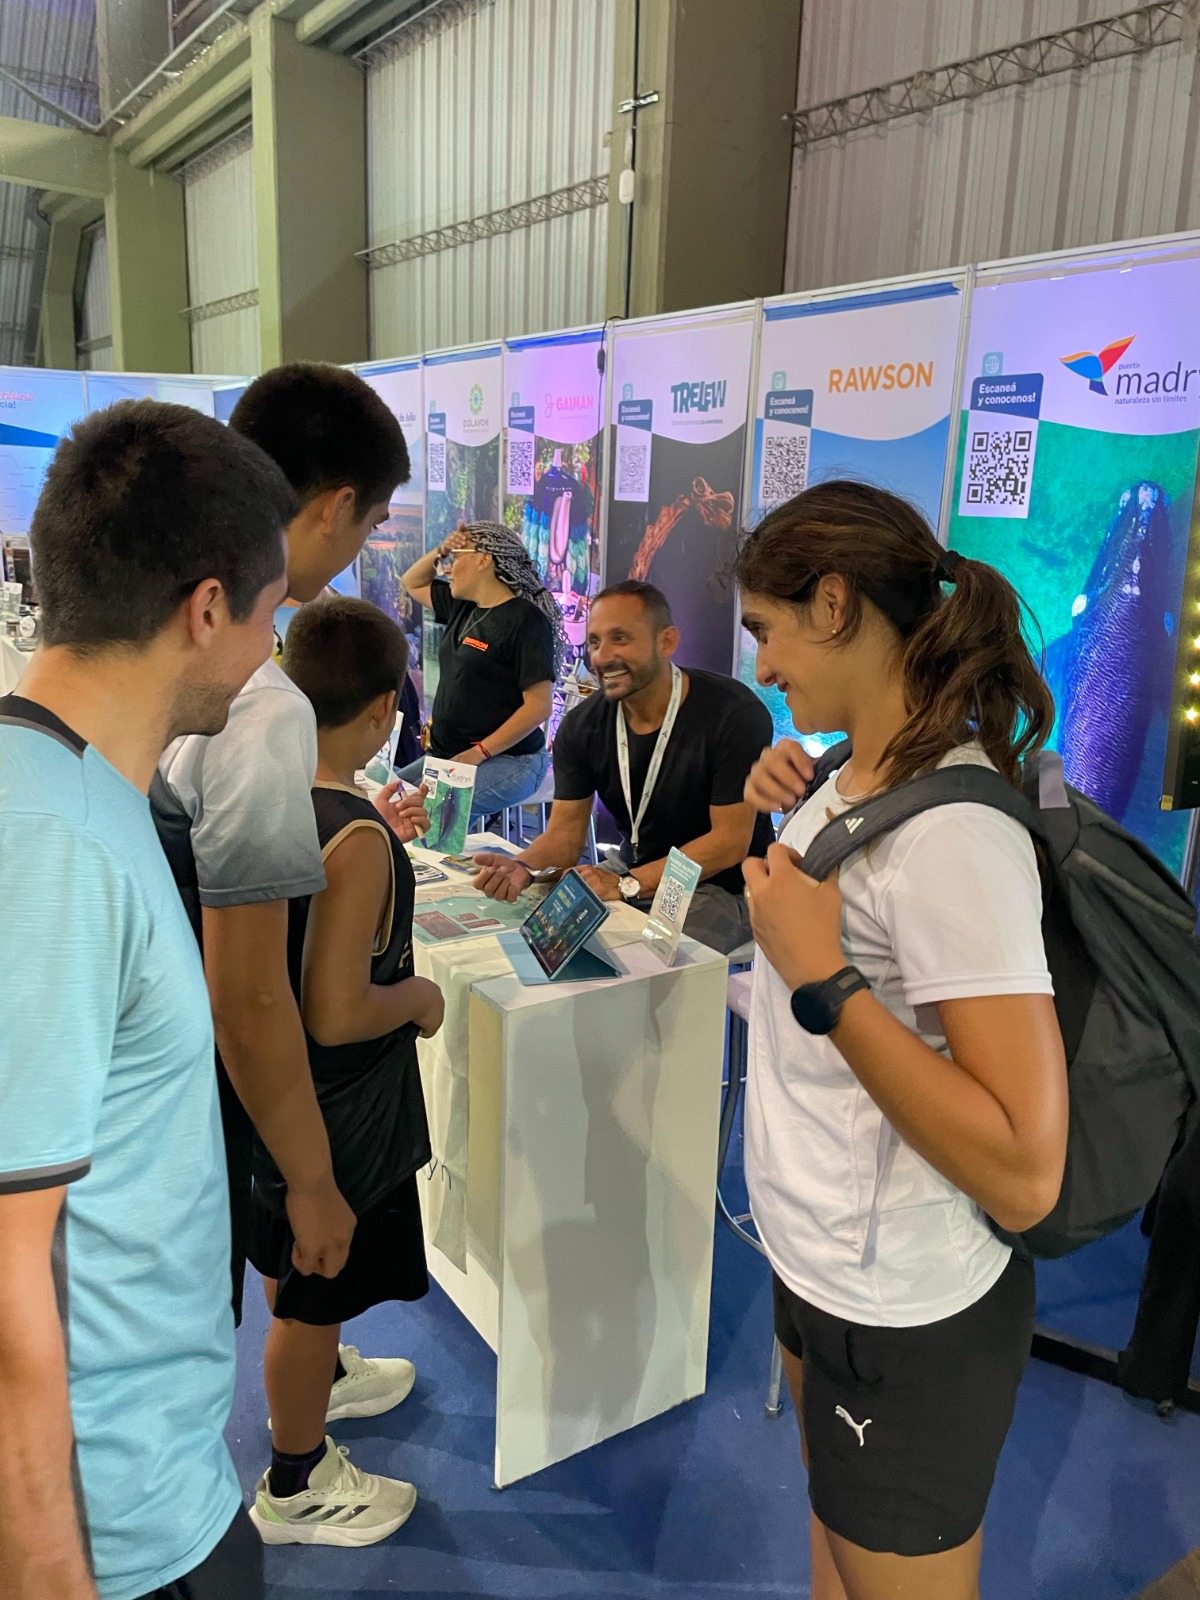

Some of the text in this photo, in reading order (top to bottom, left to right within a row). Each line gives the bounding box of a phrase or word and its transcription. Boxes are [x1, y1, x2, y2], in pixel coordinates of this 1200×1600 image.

[1118, 362, 1140, 371] puerto
[828, 360, 935, 394] RAWSON
[1115, 360, 1200, 399] madr
[979, 381, 1017, 394] Escaneá
[556, 394, 594, 411] GAIMAN
[671, 379, 728, 414] TRELEW
[977, 391, 1036, 407] y conocenos!
[1114, 396, 1150, 405] naturaleza
[1152, 396, 1162, 404] sin
[768, 408, 774, 417] y
[463, 419, 489, 428] DOLAVON
